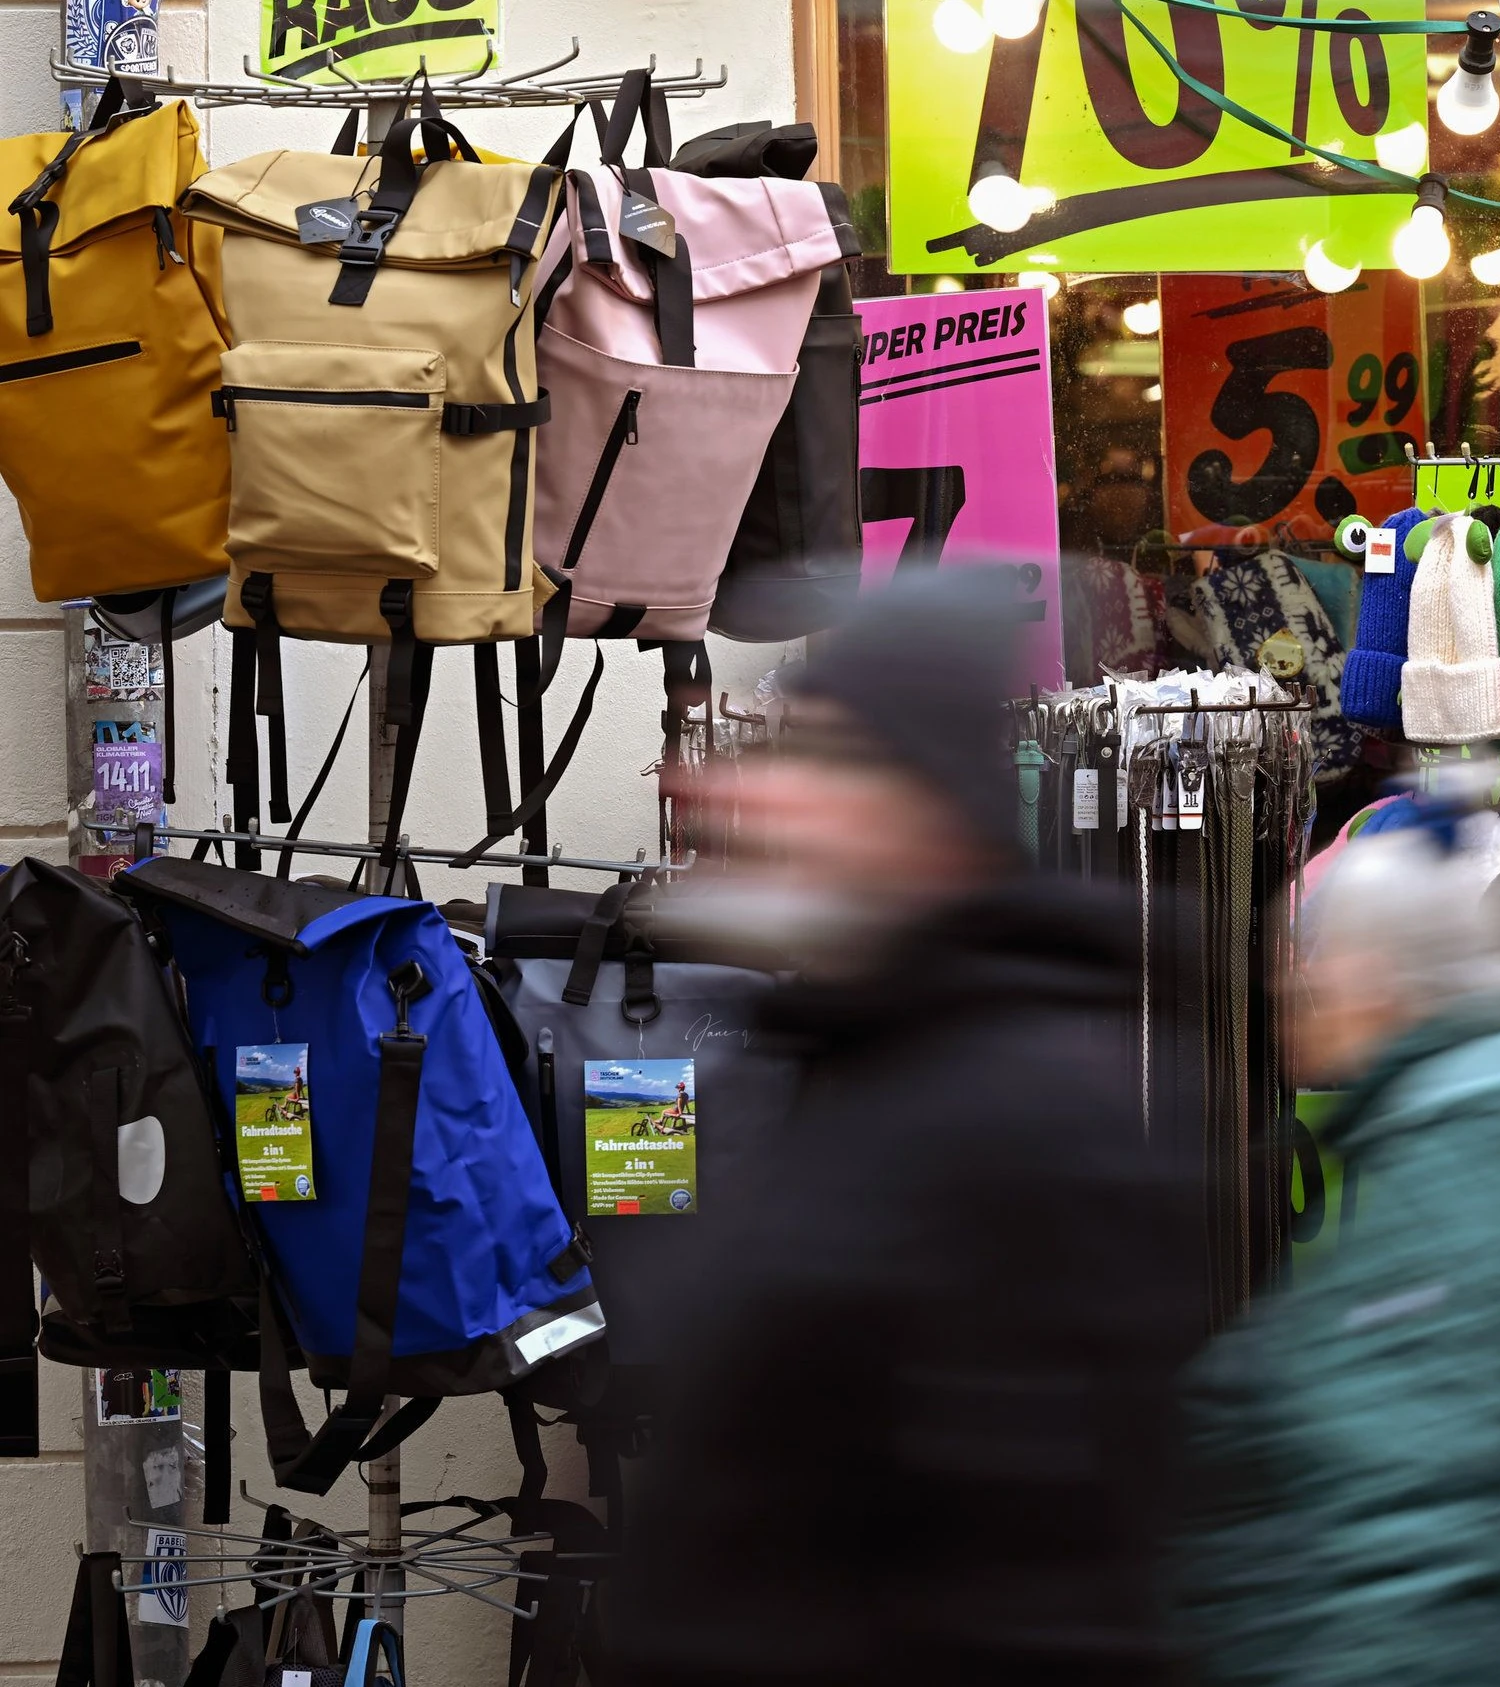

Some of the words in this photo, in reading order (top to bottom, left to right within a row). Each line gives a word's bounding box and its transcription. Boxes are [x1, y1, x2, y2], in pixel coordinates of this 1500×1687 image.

[933, 301, 1027, 350] PREIS
[97, 760, 156, 792] 14.11.
[241, 1123, 302, 1137] Fahrradtasche
[263, 1146, 269, 1156] 2
[269, 1144, 279, 1156] in
[279, 1146, 284, 1155] 1
[595, 1138, 684, 1151] Fahrradtasche
[625, 1161, 632, 1170] 2
[634, 1157, 647, 1170] in
[648, 1160, 655, 1170] 1
